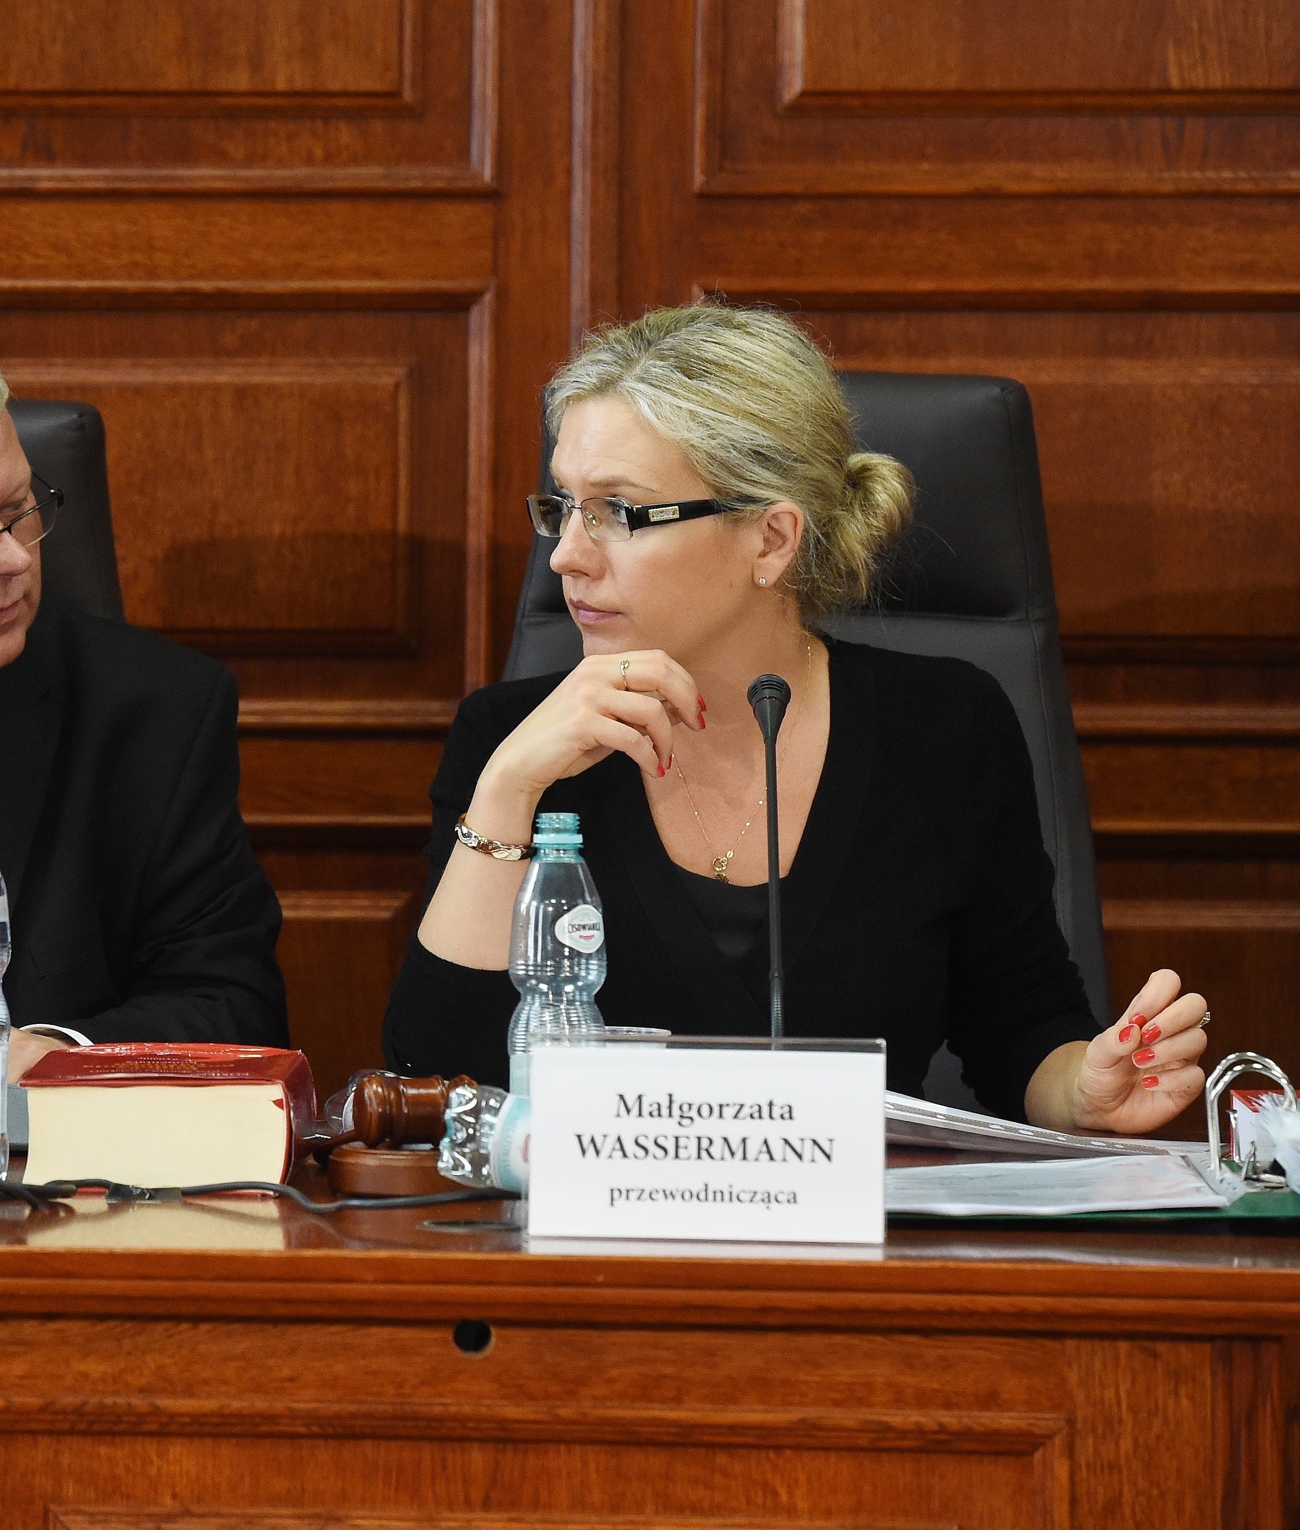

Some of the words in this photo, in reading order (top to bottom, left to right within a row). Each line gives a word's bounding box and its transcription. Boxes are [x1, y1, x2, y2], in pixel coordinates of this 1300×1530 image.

[614, 1092, 796, 1128] Małgorzata
[574, 1132, 836, 1164] WASSERMANN
[608, 1182, 799, 1210] przewodnicząca
